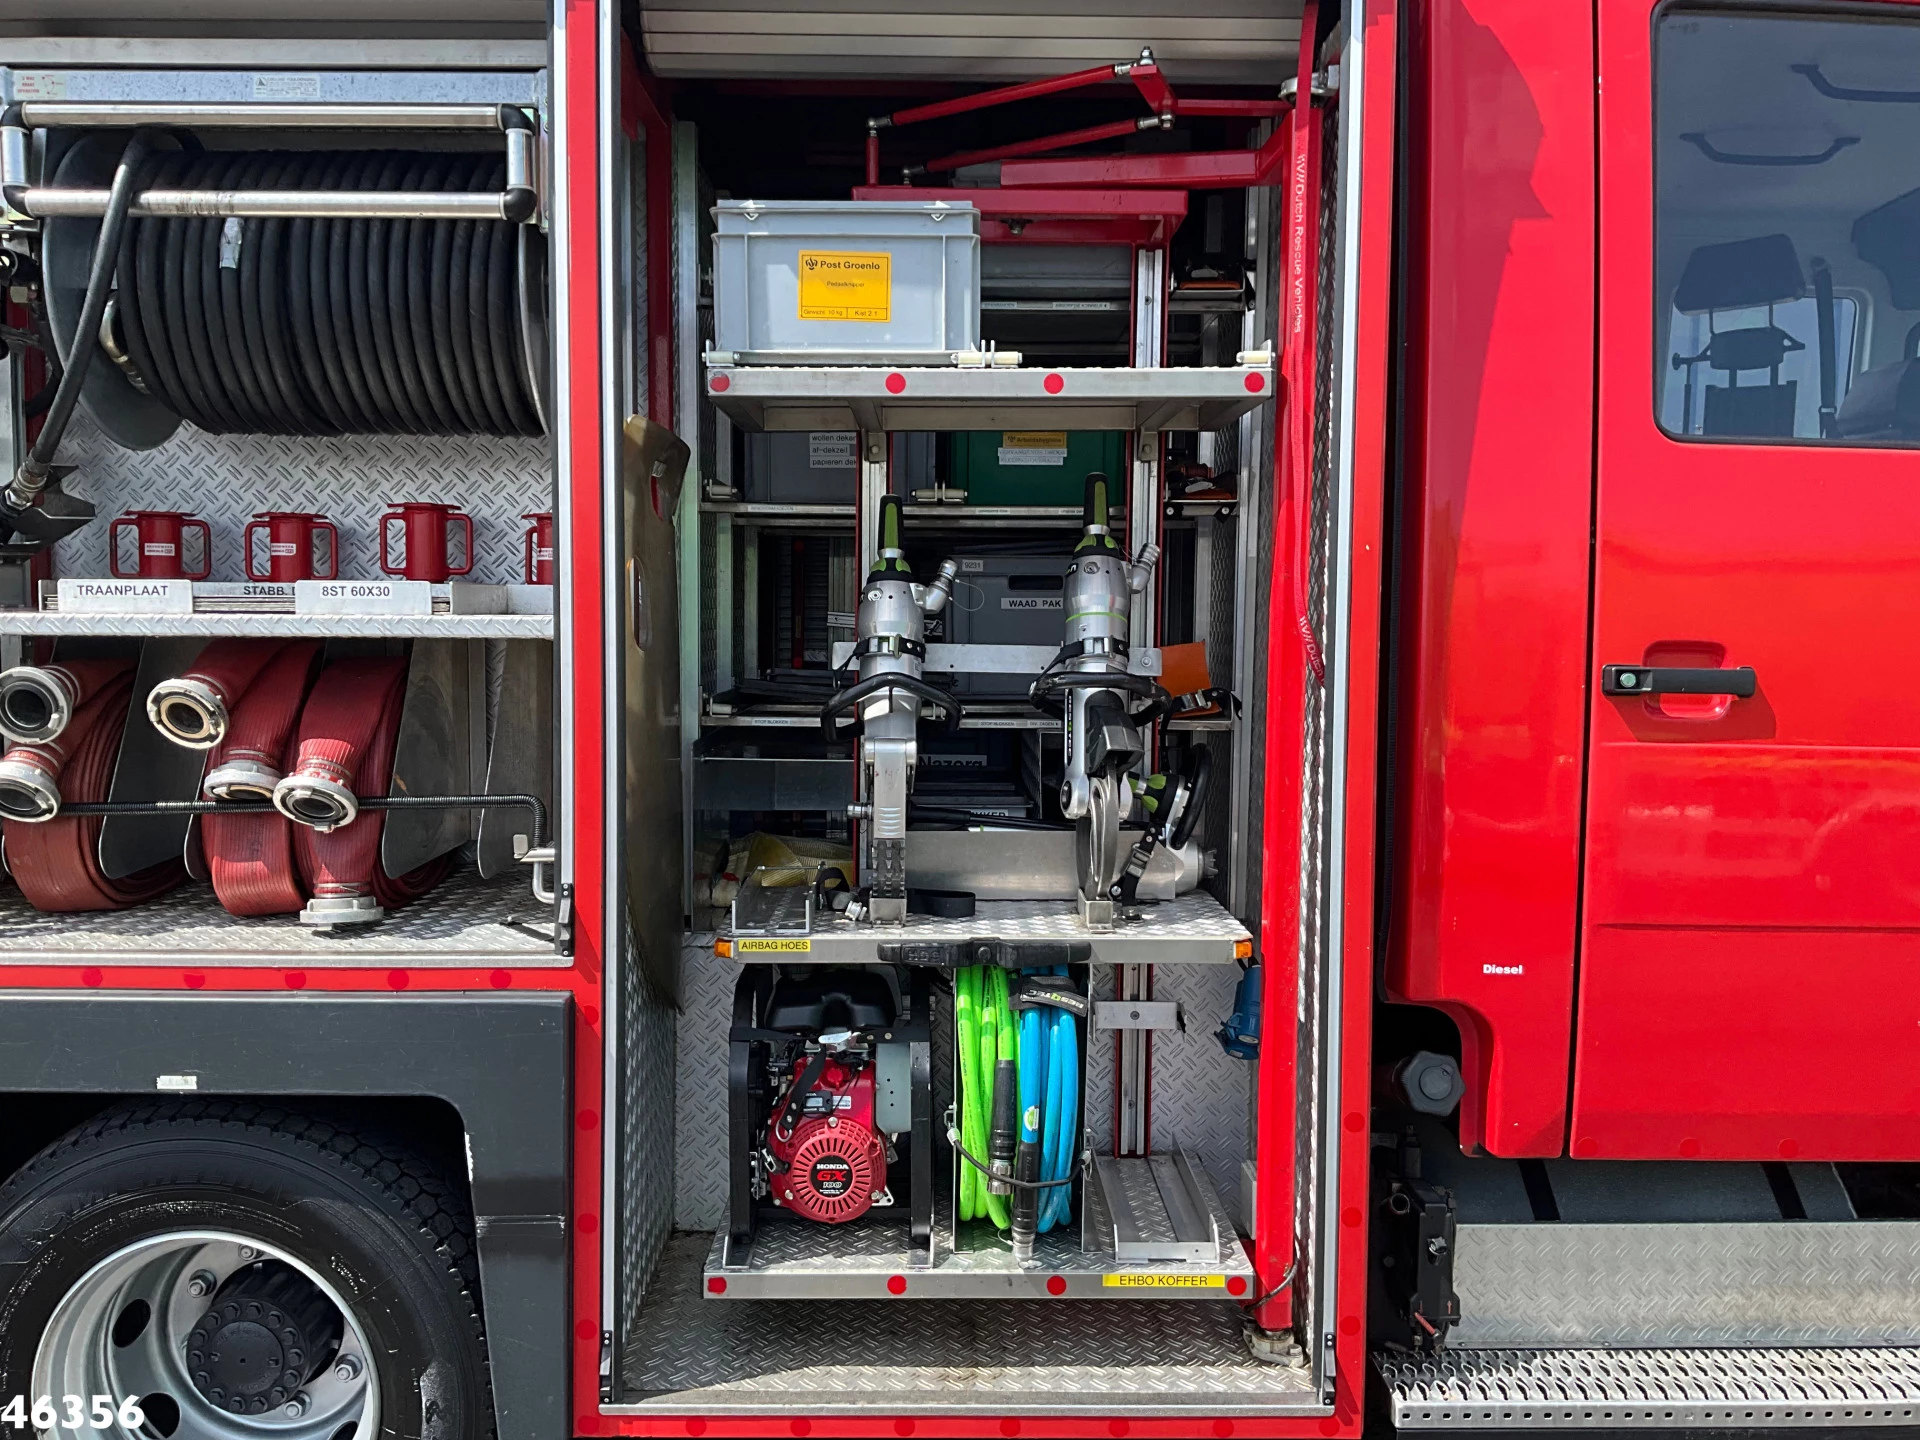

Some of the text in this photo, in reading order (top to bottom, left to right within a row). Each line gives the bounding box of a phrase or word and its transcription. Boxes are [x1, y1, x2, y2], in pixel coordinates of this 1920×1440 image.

[1294, 184, 1305, 223] Dutch
[1294, 226, 1304, 275] Rescue
[820, 260, 880, 270] Post Groenlo
[1294, 277, 1303, 333] Vehicles
[812, 459, 842, 467] papieren
[964, 561, 981, 569] 9231
[76, 585, 169, 596] TRAANPLAAT
[243, 585, 288, 595] STABB.
[321, 585, 391, 597] 8ST 60X30
[1008, 599, 1062, 608] WAAD PAK
[1306, 643, 1324, 677] Dutch
[741, 941, 808, 950] AIRBAG HOES
[1482, 963, 1523, 974] Diesel
[816, 1170, 847, 1181] GX
[1119, 1275, 1208, 1286] EHBO KOFFER
